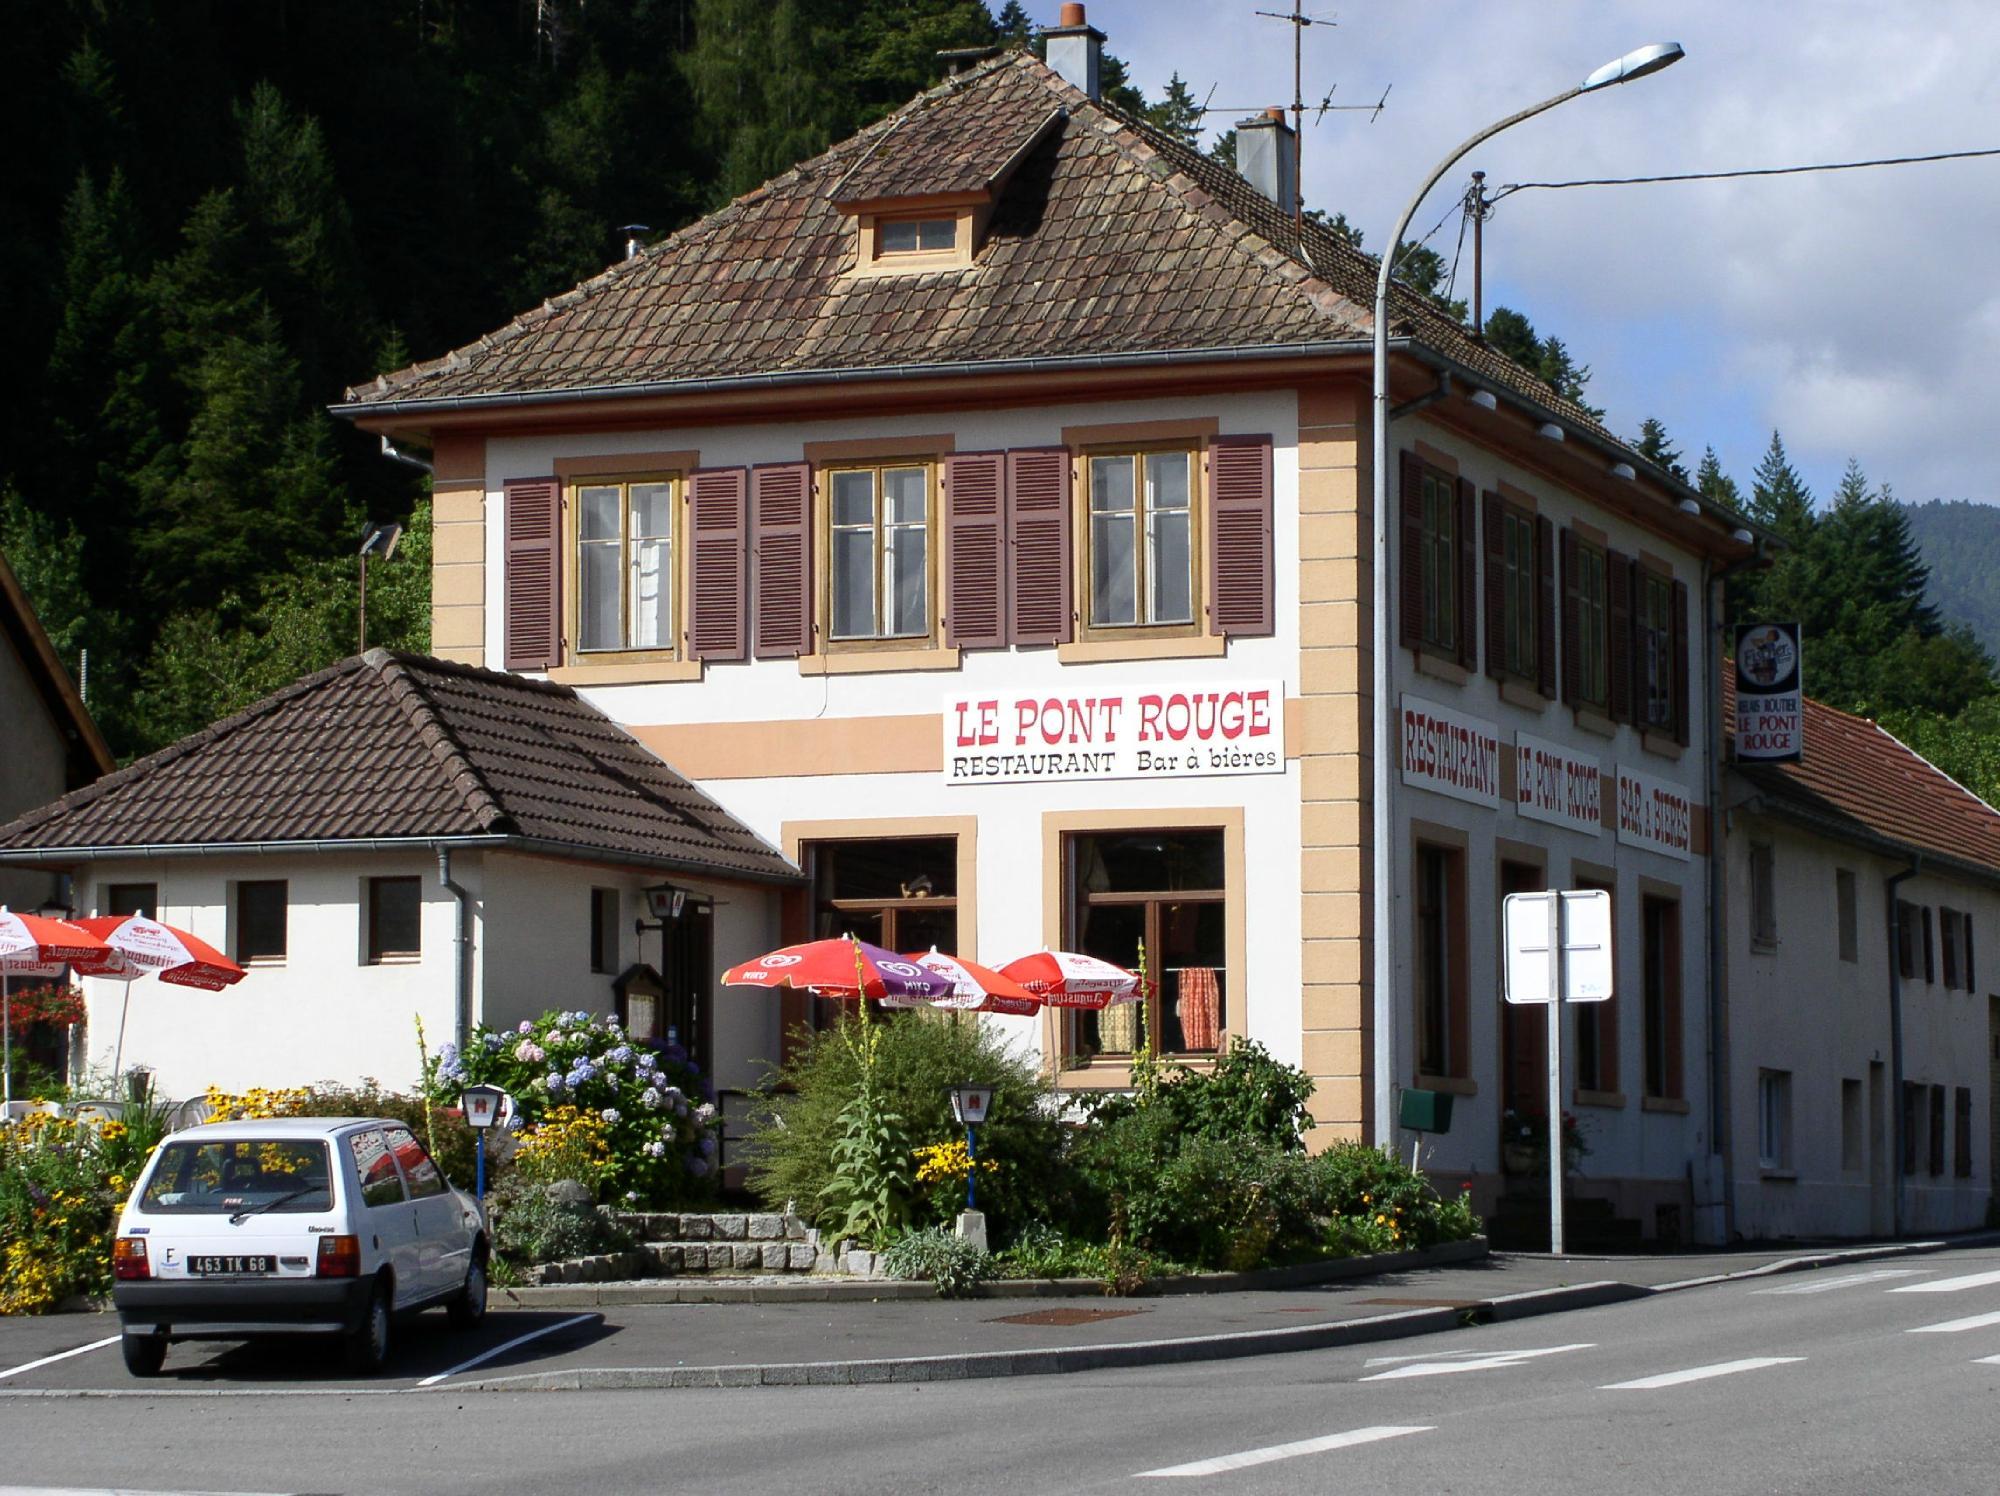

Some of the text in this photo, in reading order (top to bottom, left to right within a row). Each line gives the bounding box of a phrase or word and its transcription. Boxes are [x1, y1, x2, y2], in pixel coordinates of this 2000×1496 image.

[955, 690, 1271, 747] LE PONT ROUGE
[1764, 698, 1797, 713] ROUTIER
[1738, 716, 1798, 732] LE PONT
[1405, 710, 1497, 796] RESTAURANT
[1744, 733, 1791, 750] ROUGE
[952, 745, 1277, 777] RESTAURANT Bar à bières
[1517, 746, 1600, 822] LE PONT ROUGE
[1620, 776, 1642, 836] BAR
[196, 1257, 221, 1272] 463
[226, 1257, 243, 1272] TK
[249, 1257, 267, 1272] 68
